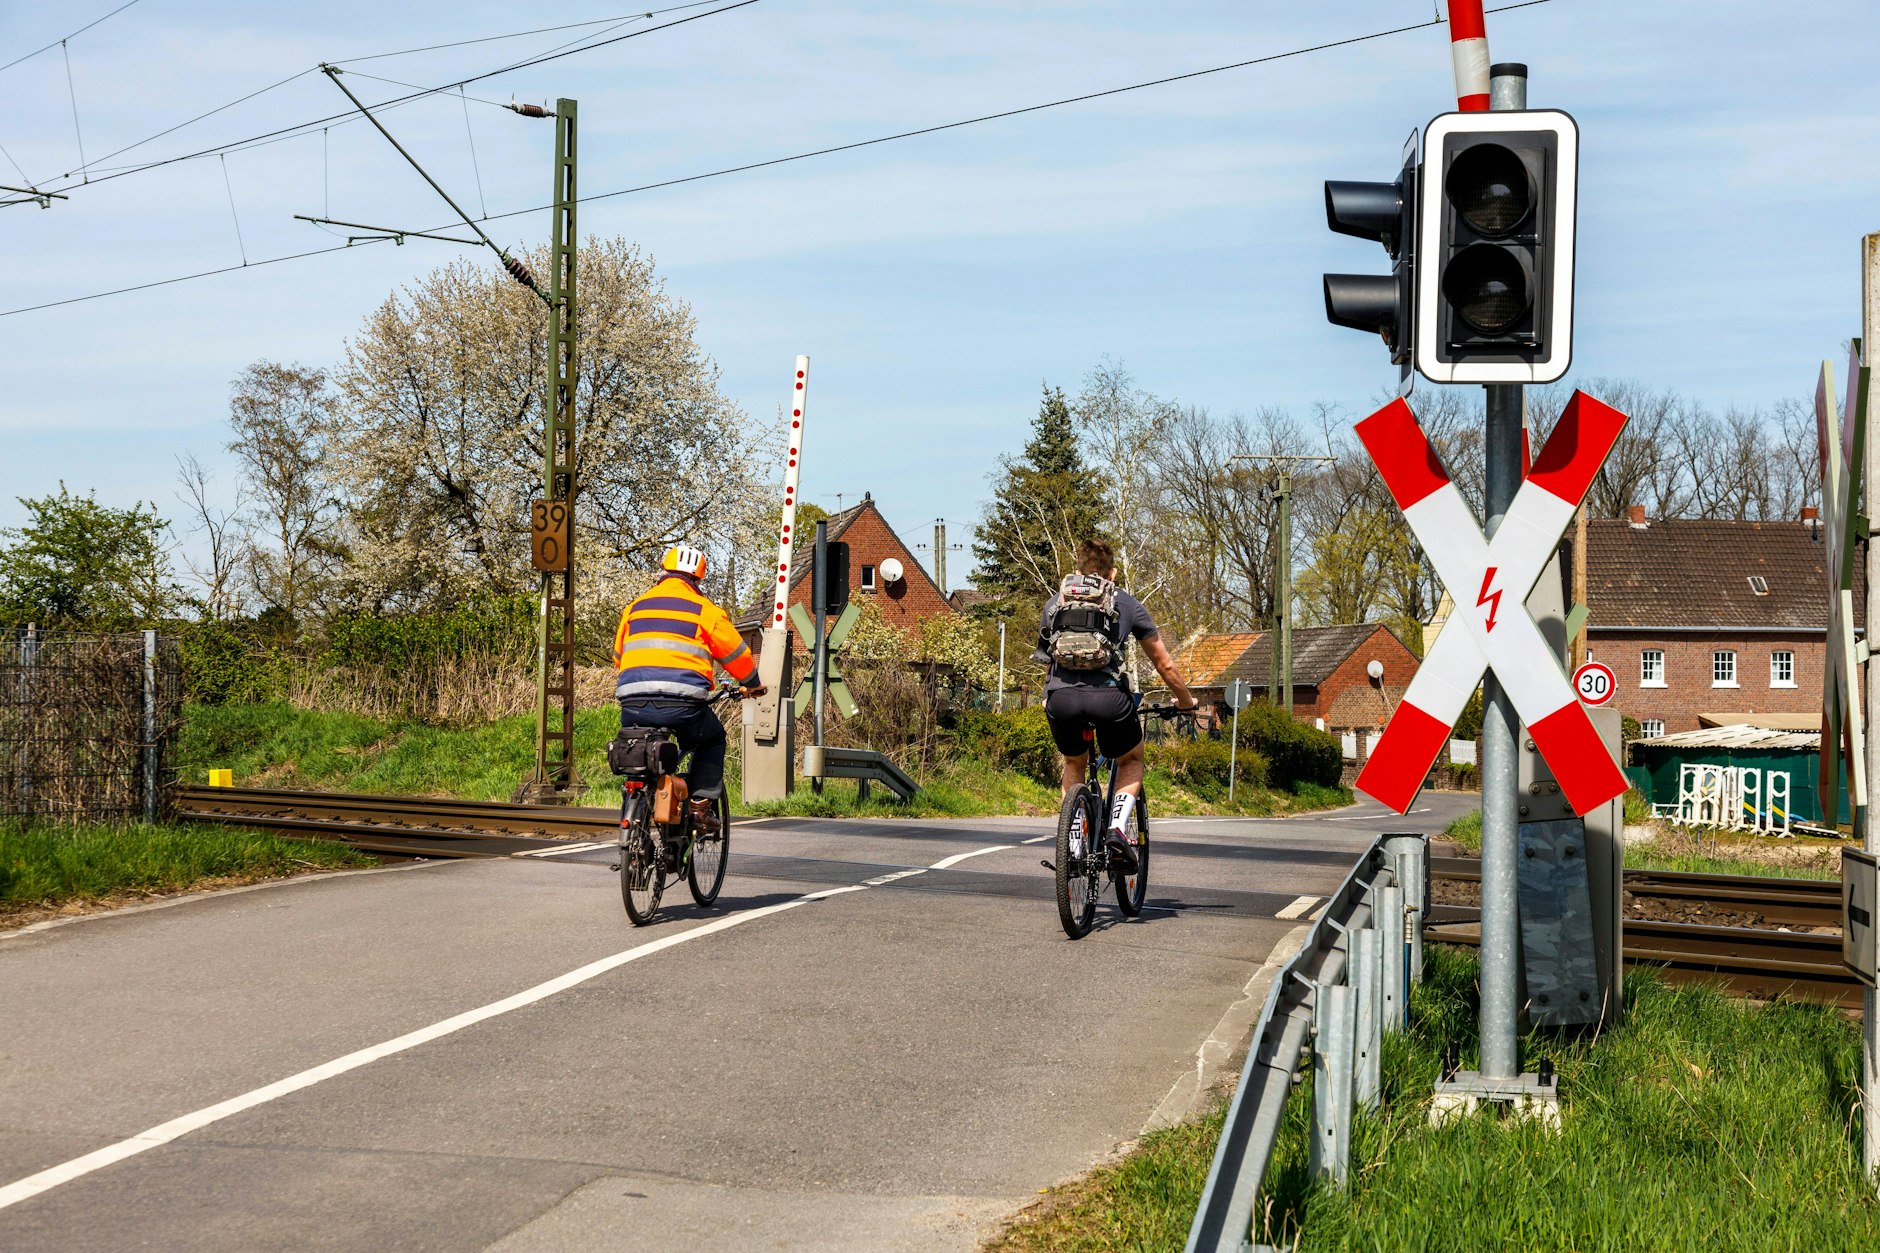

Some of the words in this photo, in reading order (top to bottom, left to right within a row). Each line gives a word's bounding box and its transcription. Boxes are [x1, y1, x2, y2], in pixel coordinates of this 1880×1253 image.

[534, 504, 566, 533] 39
[540, 536, 559, 565] 0
[1581, 674, 1606, 694] 30
